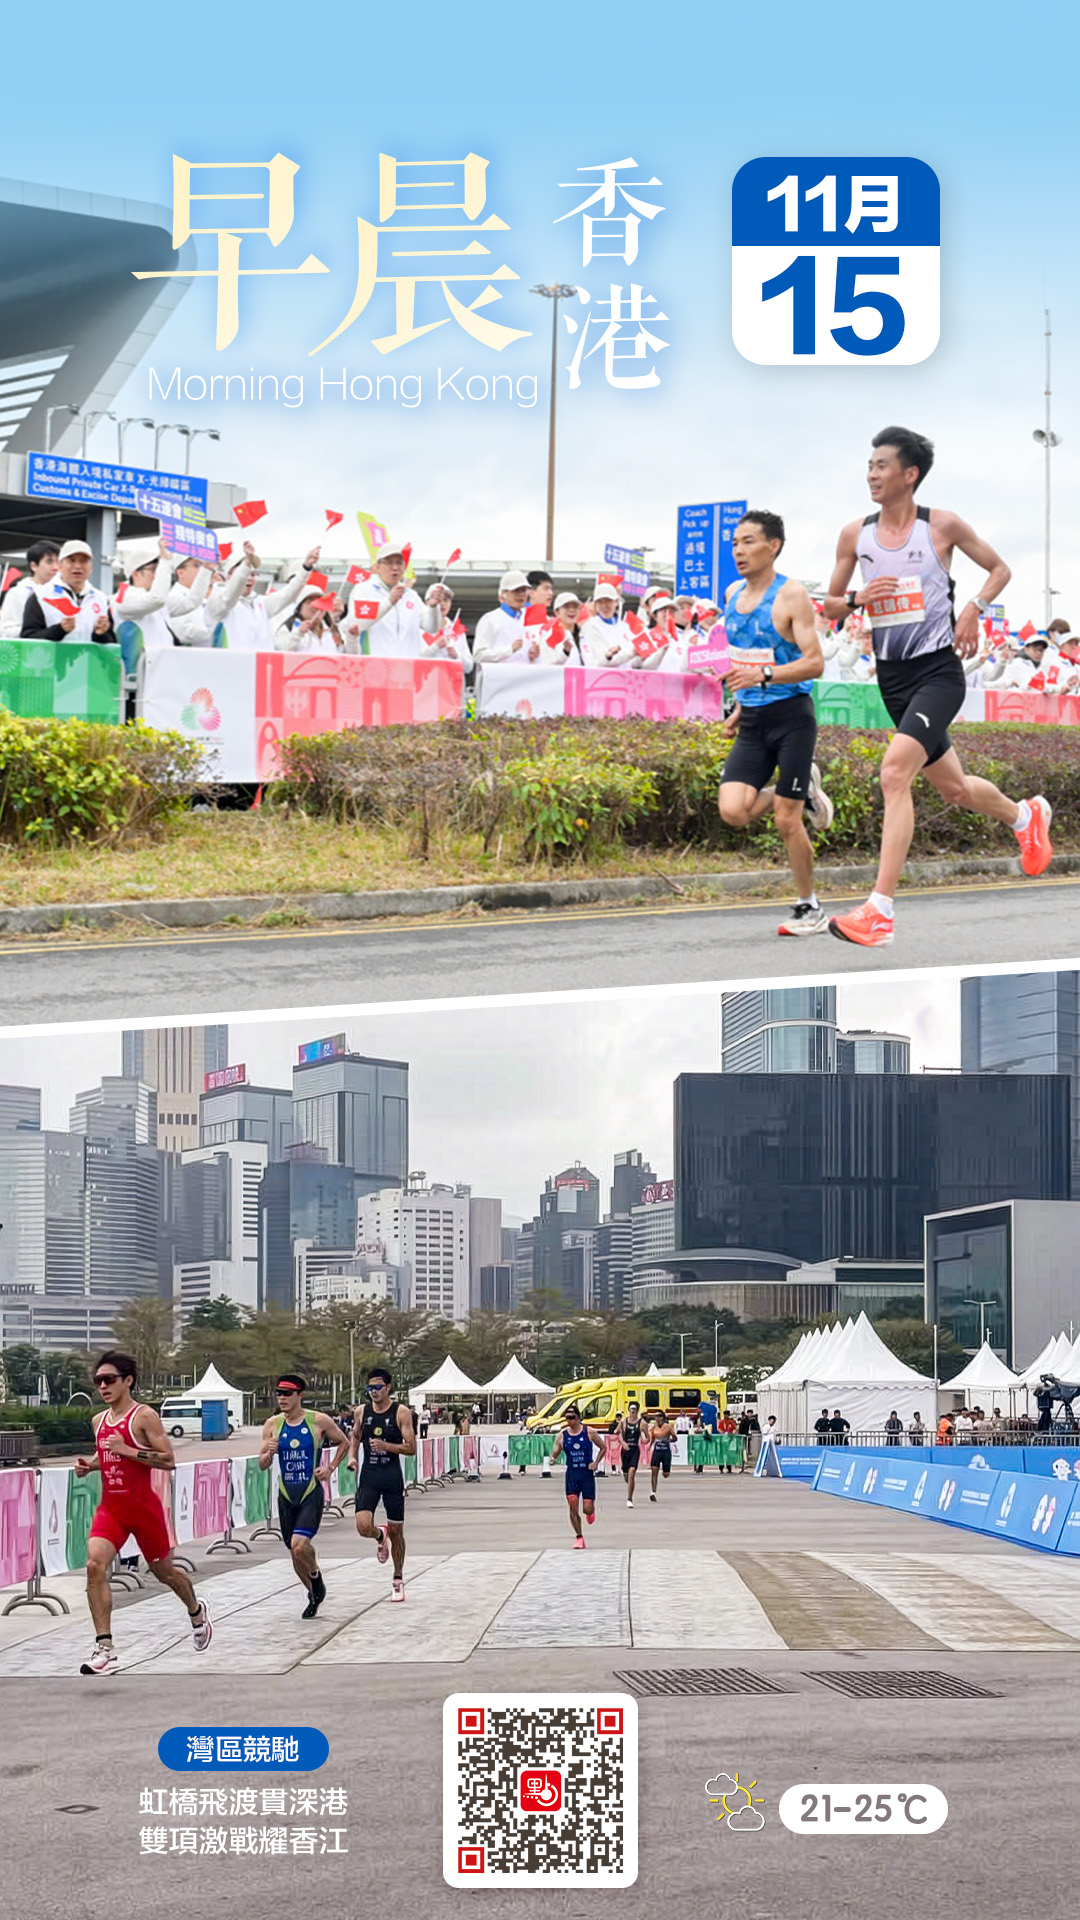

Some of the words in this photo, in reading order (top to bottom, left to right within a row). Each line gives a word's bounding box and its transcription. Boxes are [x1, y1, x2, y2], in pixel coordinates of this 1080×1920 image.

[33, 472, 70, 486] Inbound
[71, 477, 102, 491] Private
[103, 481, 120, 493] Car
[32, 482, 72, 498] Customs
[74, 487, 81, 498] &
[82, 488, 109, 502] Excise
[684, 509, 707, 518] Coach
[723, 506, 743, 515] Hong
[682, 520, 697, 528] Pick
[684, 559, 705, 573] 巴士
[679, 575, 710, 590] 上客區
